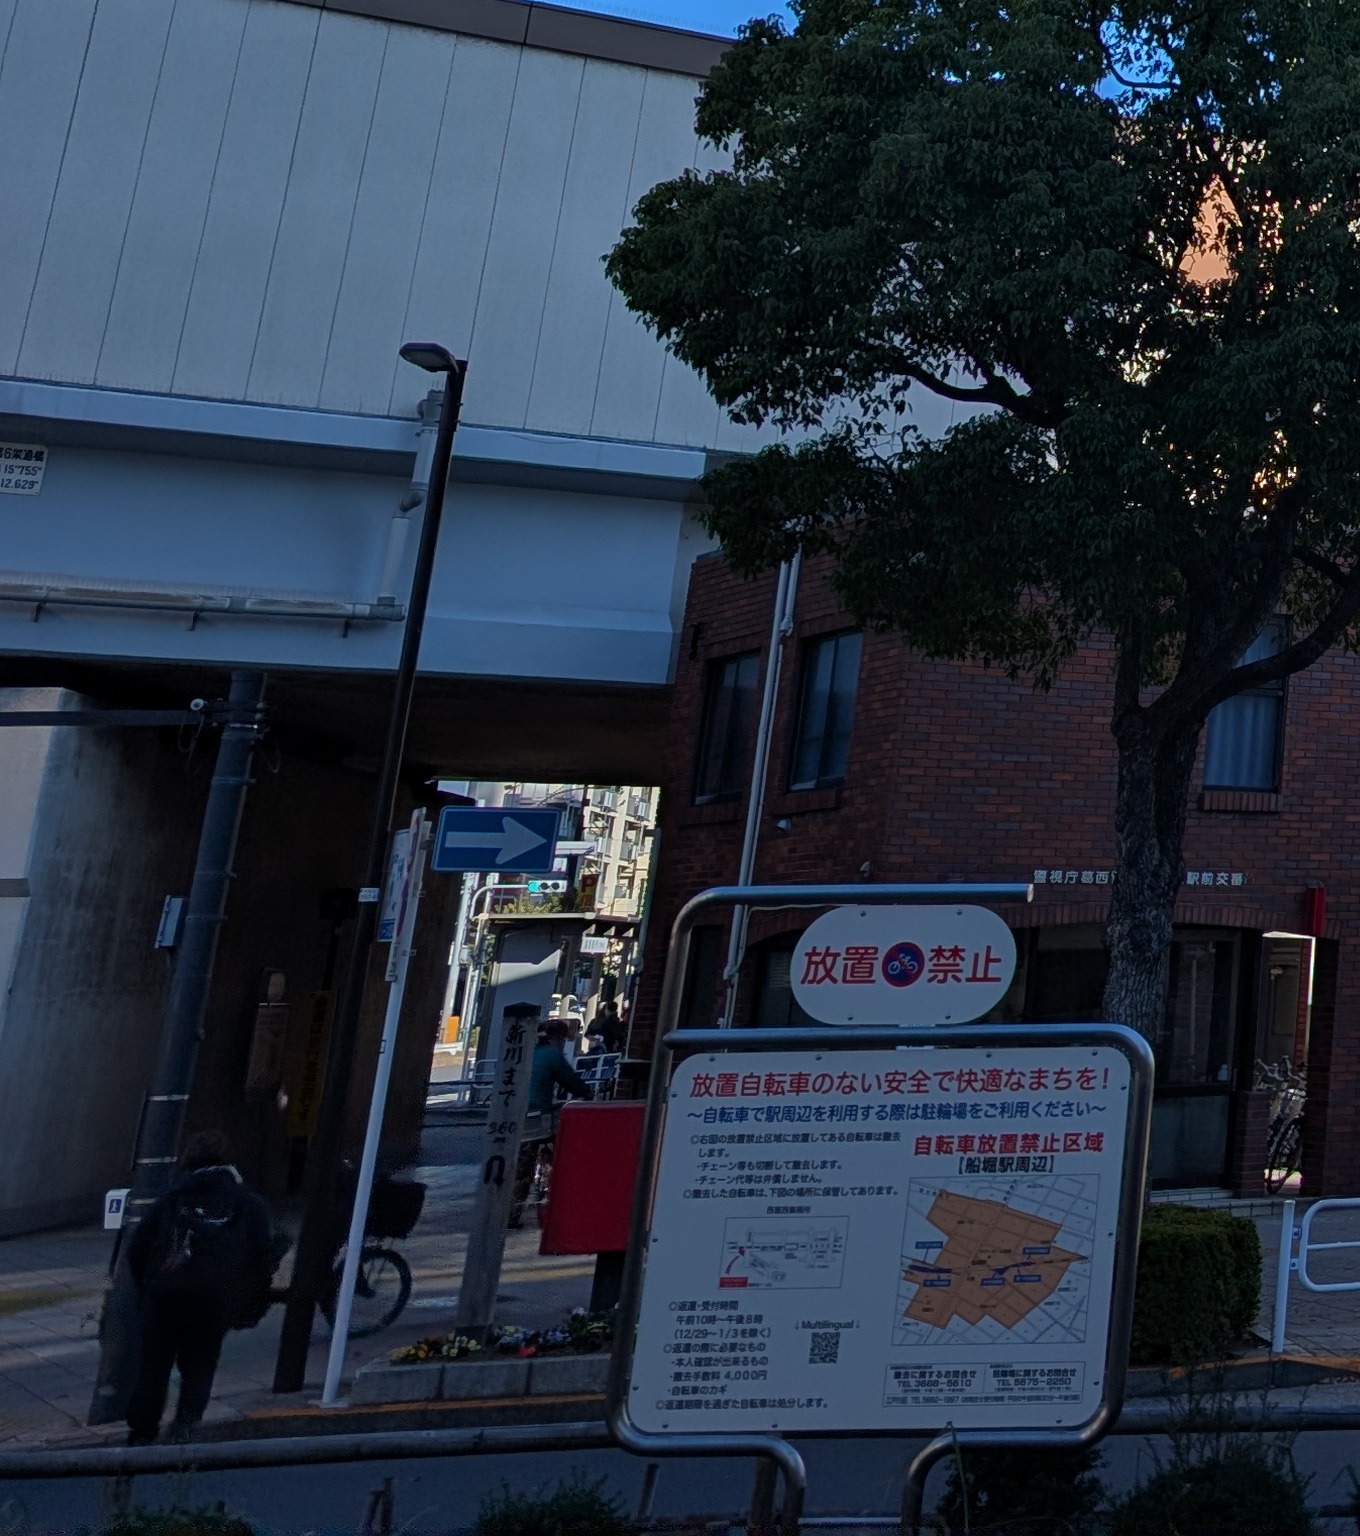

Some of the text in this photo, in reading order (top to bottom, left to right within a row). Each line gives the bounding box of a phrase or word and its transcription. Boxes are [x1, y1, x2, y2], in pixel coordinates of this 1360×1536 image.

[1187, 871, 1244, 885] 駅前交番
[801, 945, 1003, 985] 放置 禁止
[498, 1024, 526, 1107] 新川まで
[689, 1067, 1110, 1098] 放置自転車のない安全で快適なまちを！
[697, 1148, 730, 1158] します。
[914, 1132, 1105, 1156] 自転車放置禁止区域
[801, 1319, 855, 1331] Multilingual
